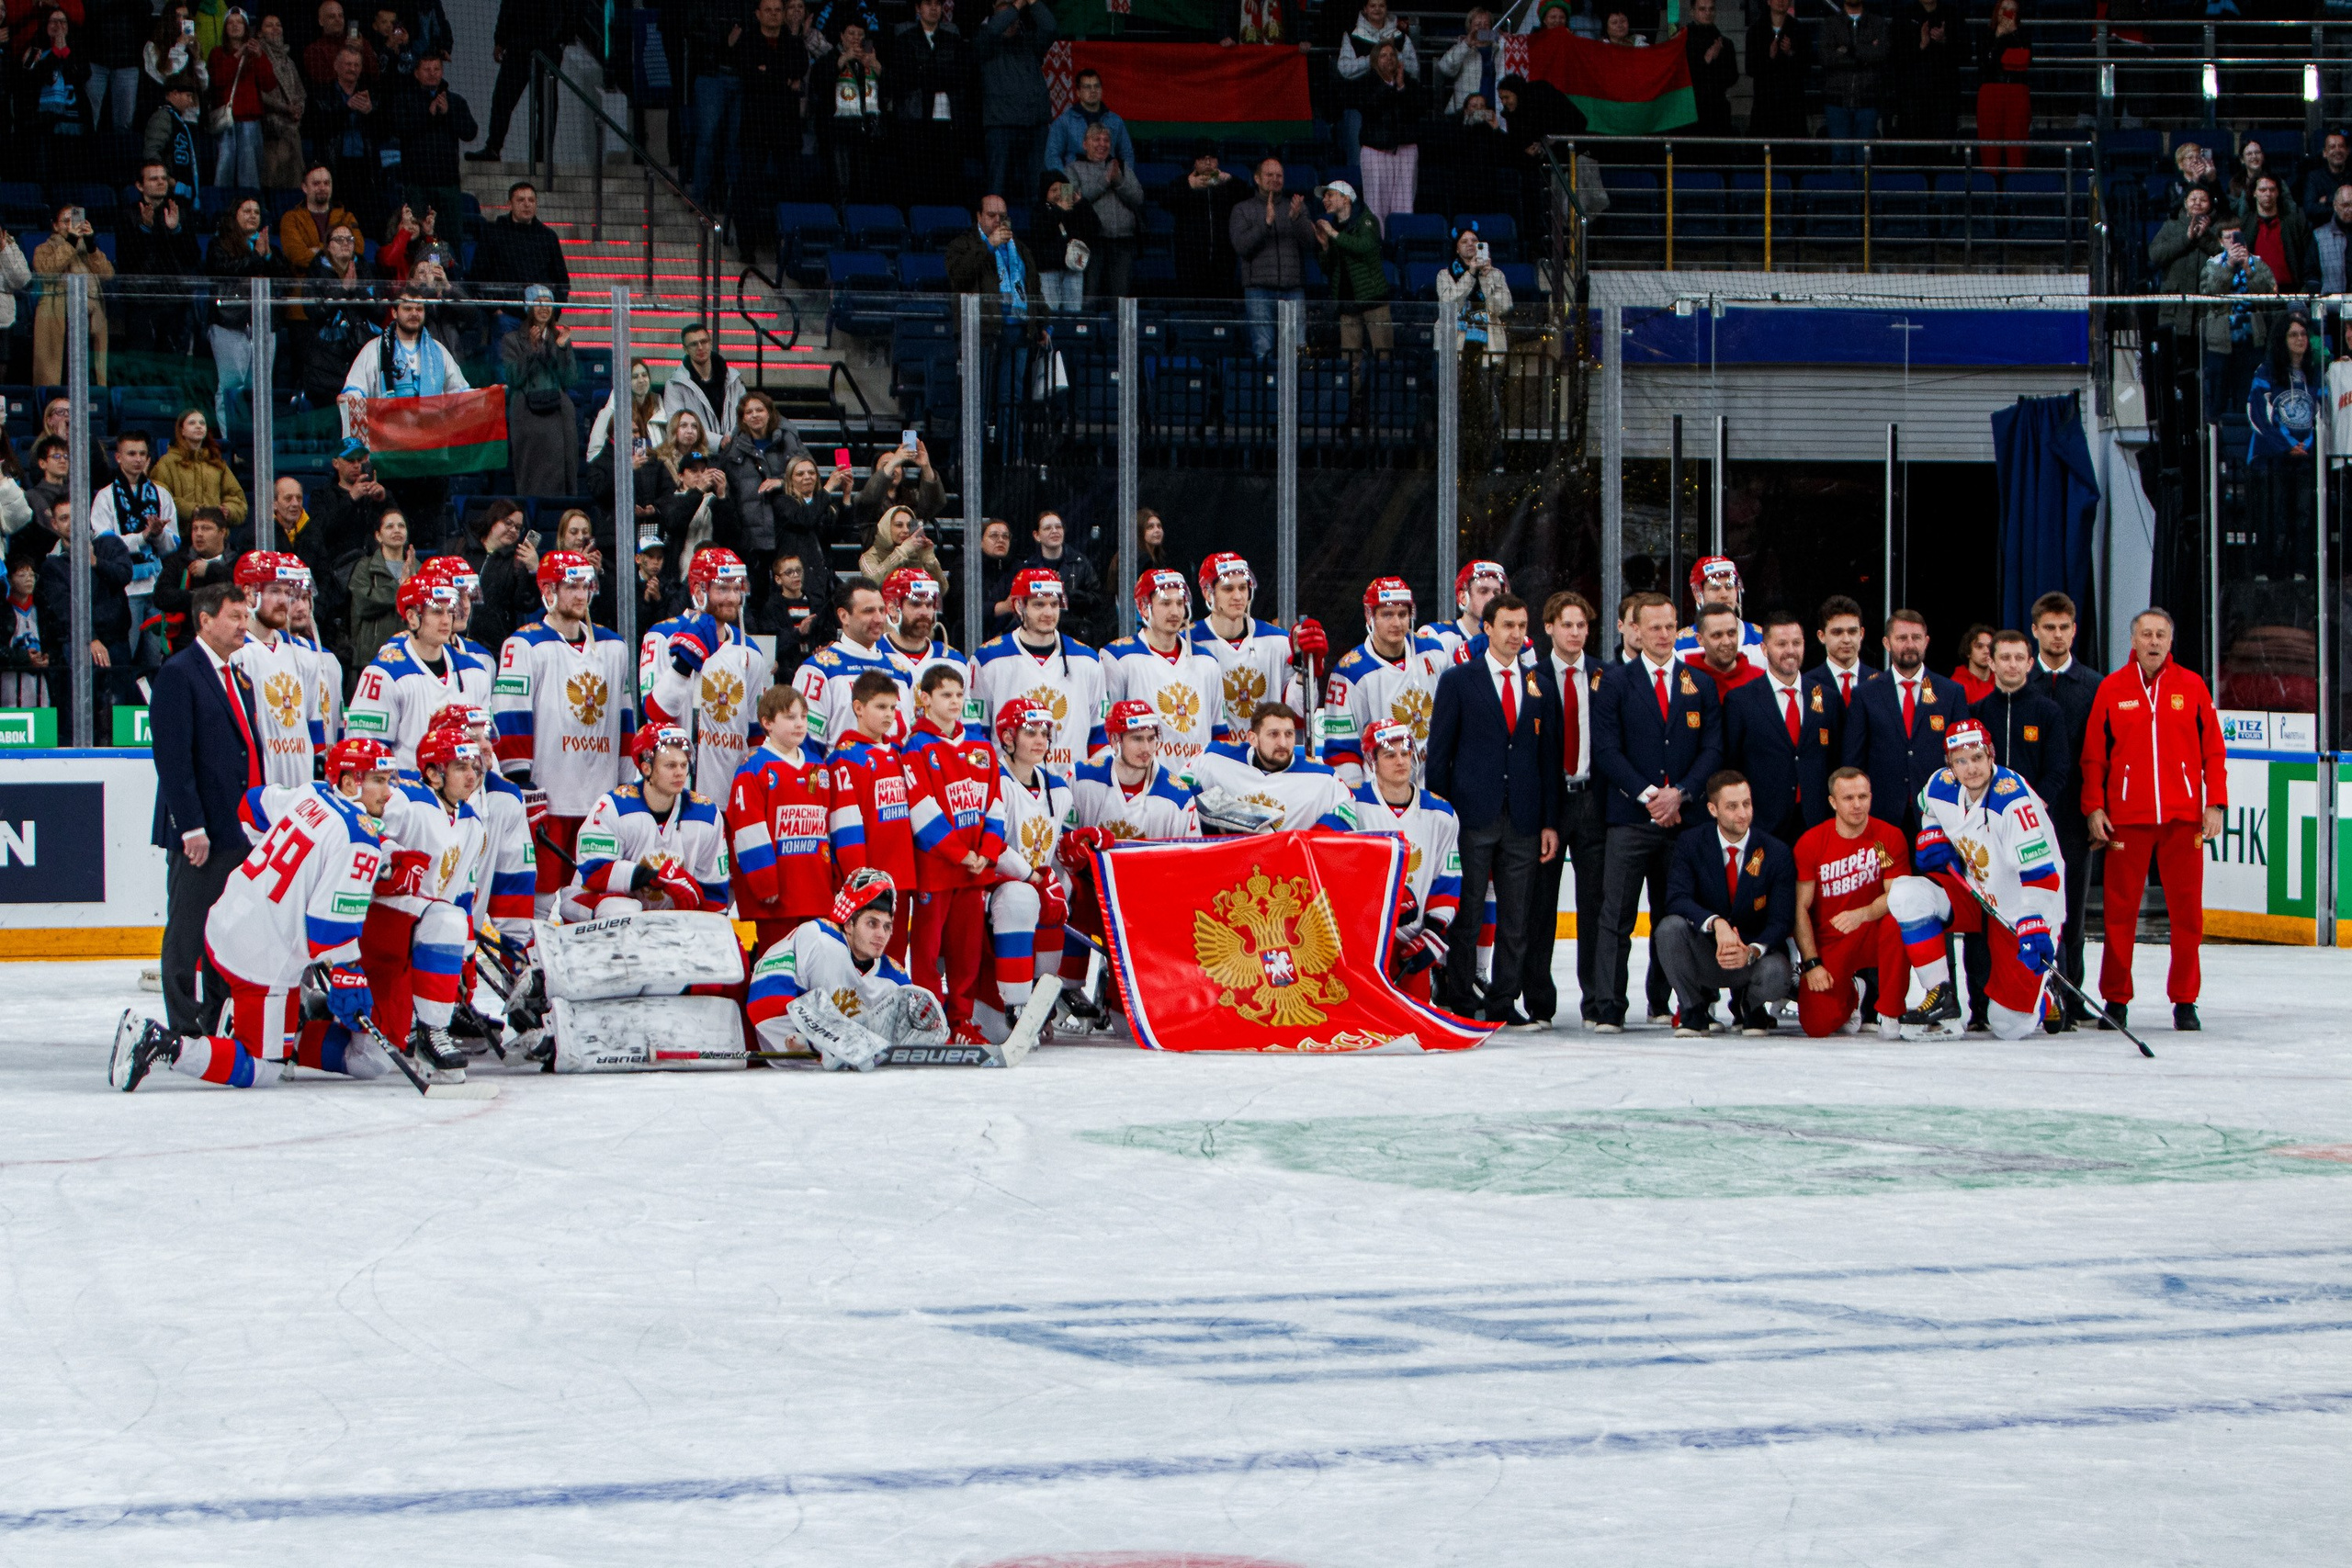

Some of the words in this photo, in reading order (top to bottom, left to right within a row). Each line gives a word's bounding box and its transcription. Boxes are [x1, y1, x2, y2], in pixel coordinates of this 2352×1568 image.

[503, 644, 514, 668] 5
[673, 635, 705, 658] BAU
[359, 673, 382, 700] 76
[803, 673, 825, 702] 13
[1325, 680, 1347, 706] 53
[2237, 720, 2263, 731] TEZ
[0, 731, 27, 743] АВОК
[562, 736, 610, 752] РОССИЯ
[698, 728, 743, 750] РОССИЯ
[1045, 748, 1070, 764] СИЯ
[834, 766, 854, 791] 12
[735, 784, 746, 811] 4
[781, 807, 819, 819] КРАСНАЯ
[2014, 804, 2040, 832] 16
[778, 818, 828, 838] МАШИНА
[1917, 830, 1943, 845] BAU
[2202, 807, 2267, 865] НК
[782, 840, 818, 854] ЮНИОР
[240, 816, 315, 904] 59
[351, 852, 379, 883] 59
[1822, 882, 1830, 897] И
[1831, 865, 1880, 897] ВВЕРХ!
[574, 917, 631, 935] BAUER
[2017, 920, 2046, 935] BAU
[332, 974, 368, 987] CCM
[793, 1005, 840, 1043] VAUGHN
[890, 1048, 981, 1064] BAUER
